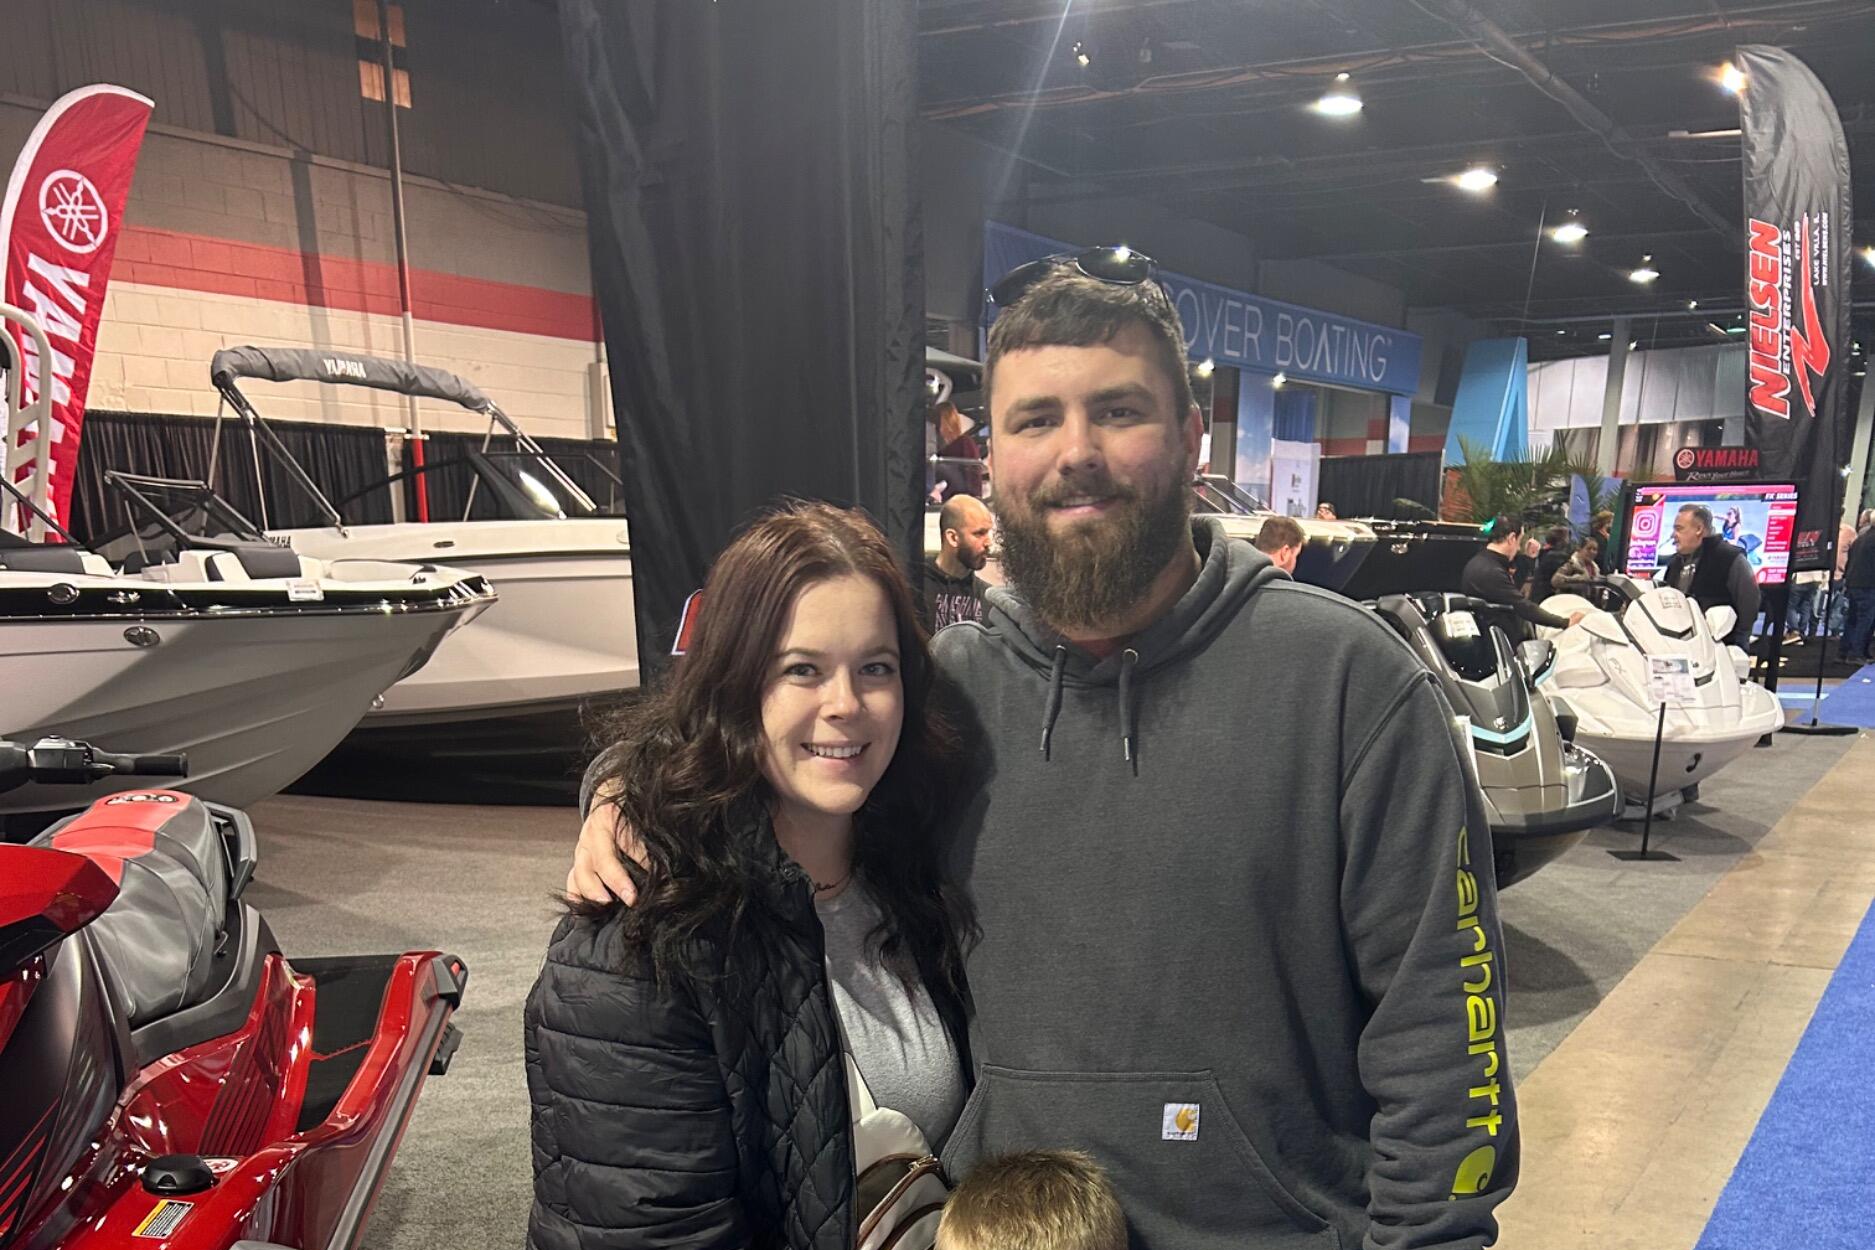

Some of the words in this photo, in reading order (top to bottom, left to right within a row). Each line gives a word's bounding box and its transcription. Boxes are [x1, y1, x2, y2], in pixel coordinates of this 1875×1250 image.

[1274, 313, 1388, 383] BOATING
[1749, 218, 1791, 420] NIELSEN
[1781, 229, 1793, 376] ENTERPRISES
[1695, 448, 1758, 468] YAMAHA
